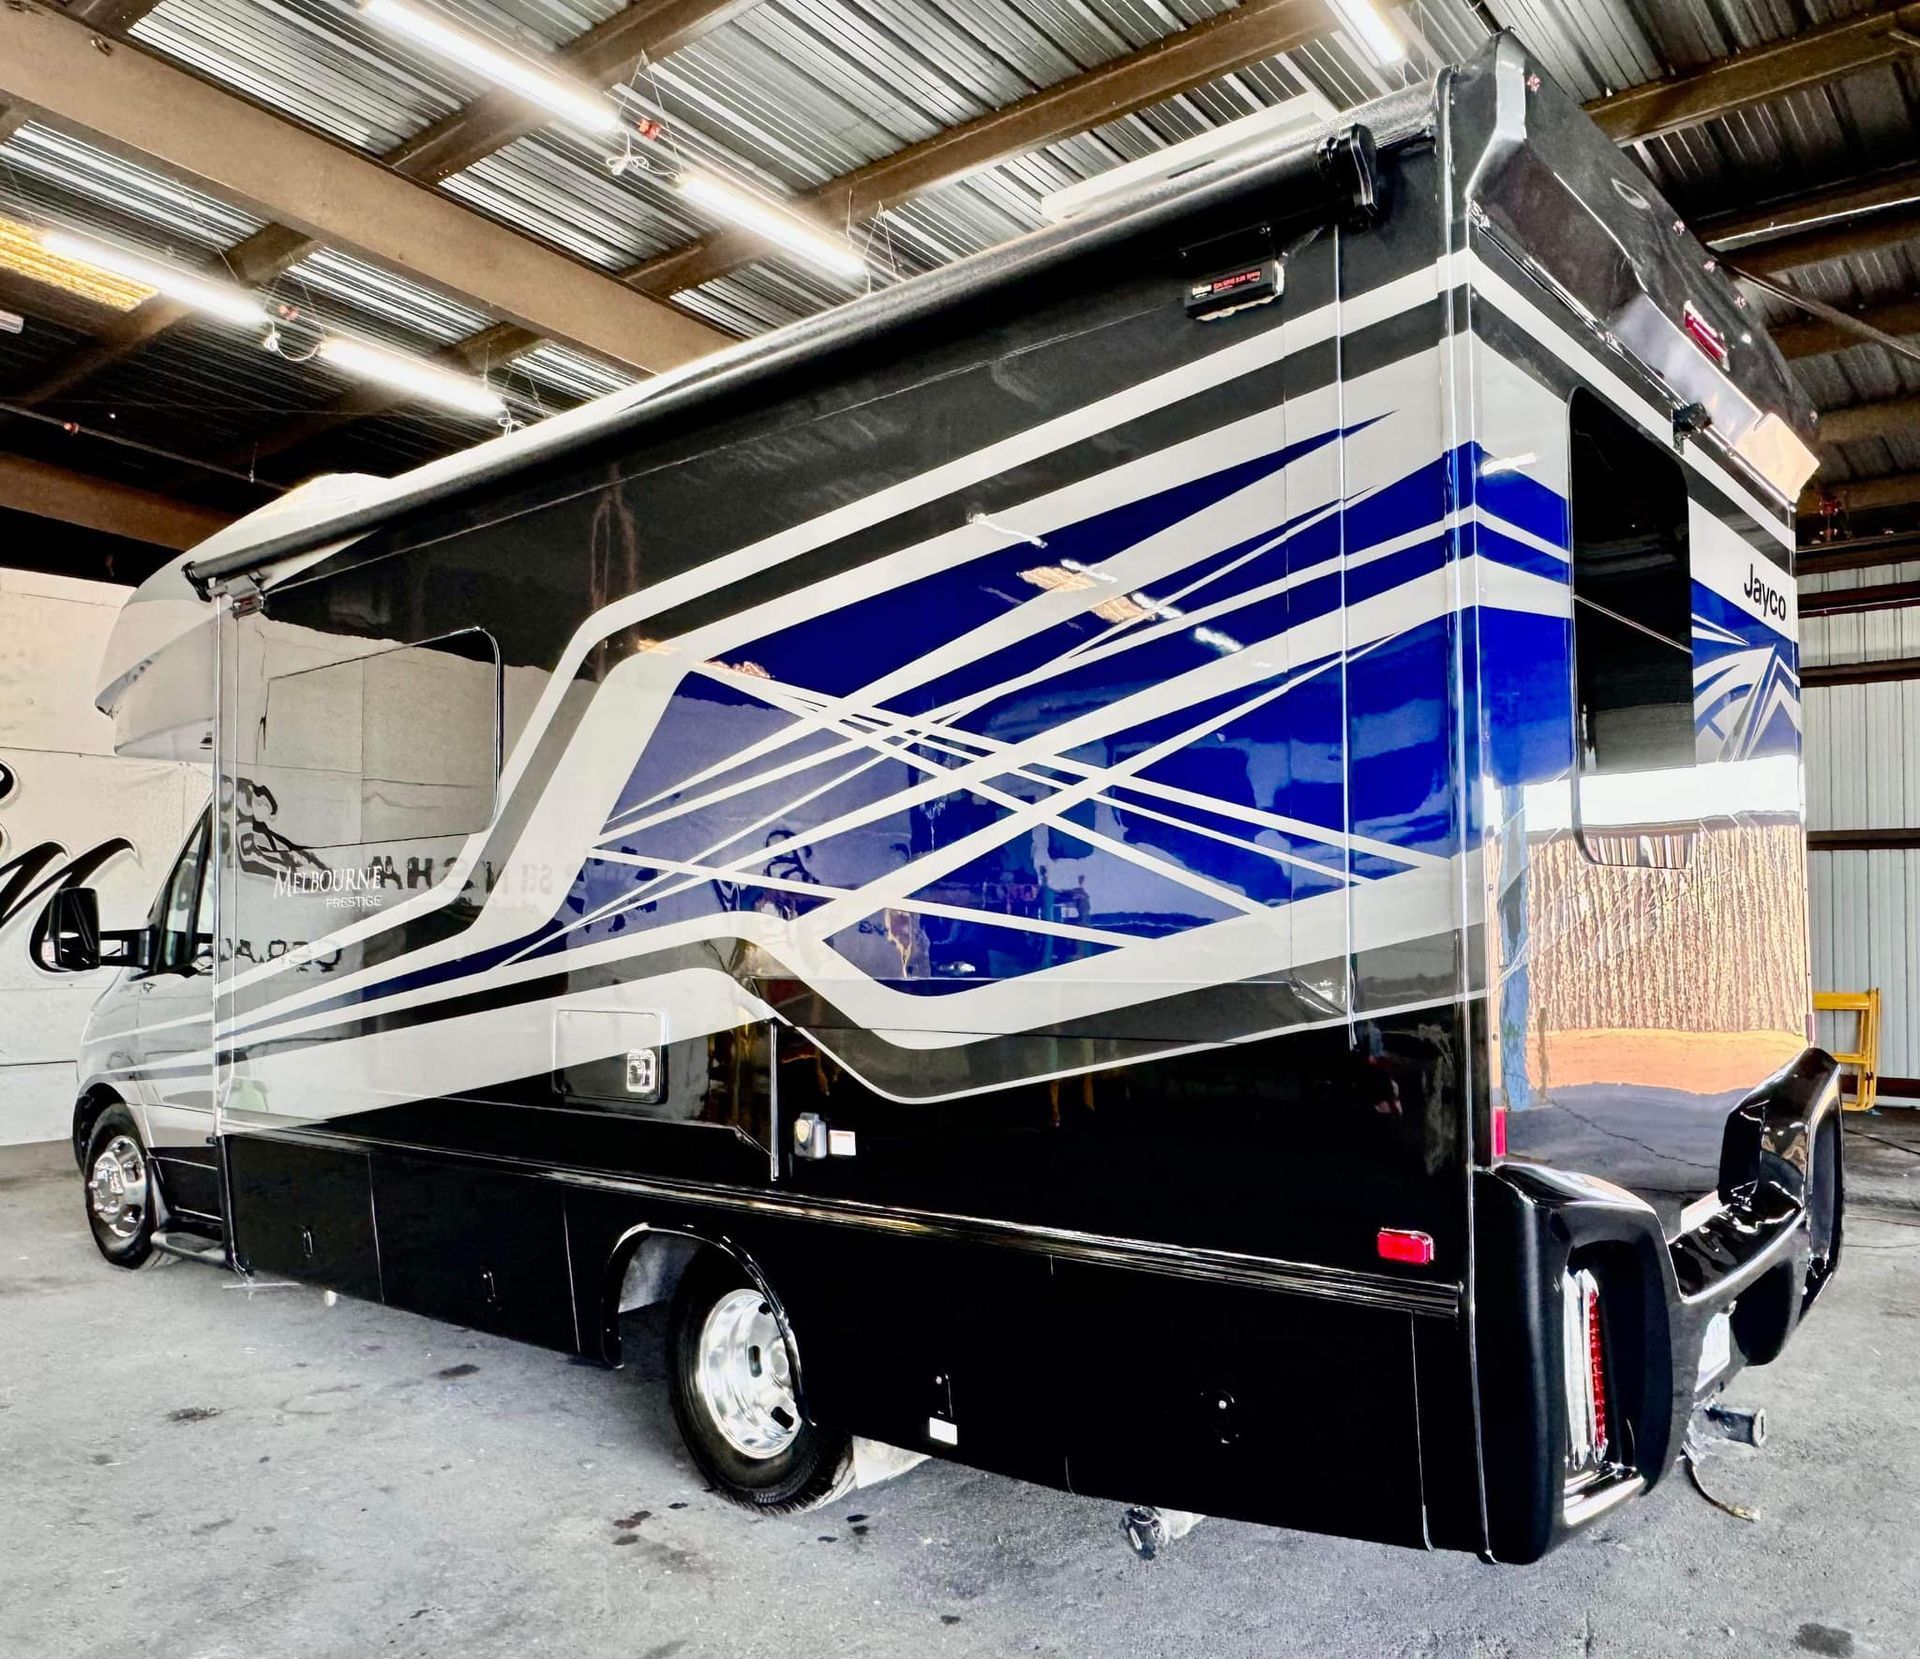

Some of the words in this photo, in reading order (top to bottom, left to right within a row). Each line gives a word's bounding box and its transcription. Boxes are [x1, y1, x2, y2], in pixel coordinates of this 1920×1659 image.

[1744, 563, 1786, 621] Jayco
[273, 866, 382, 898] MELBOURNE
[326, 895, 382, 908] PRESTIGE
